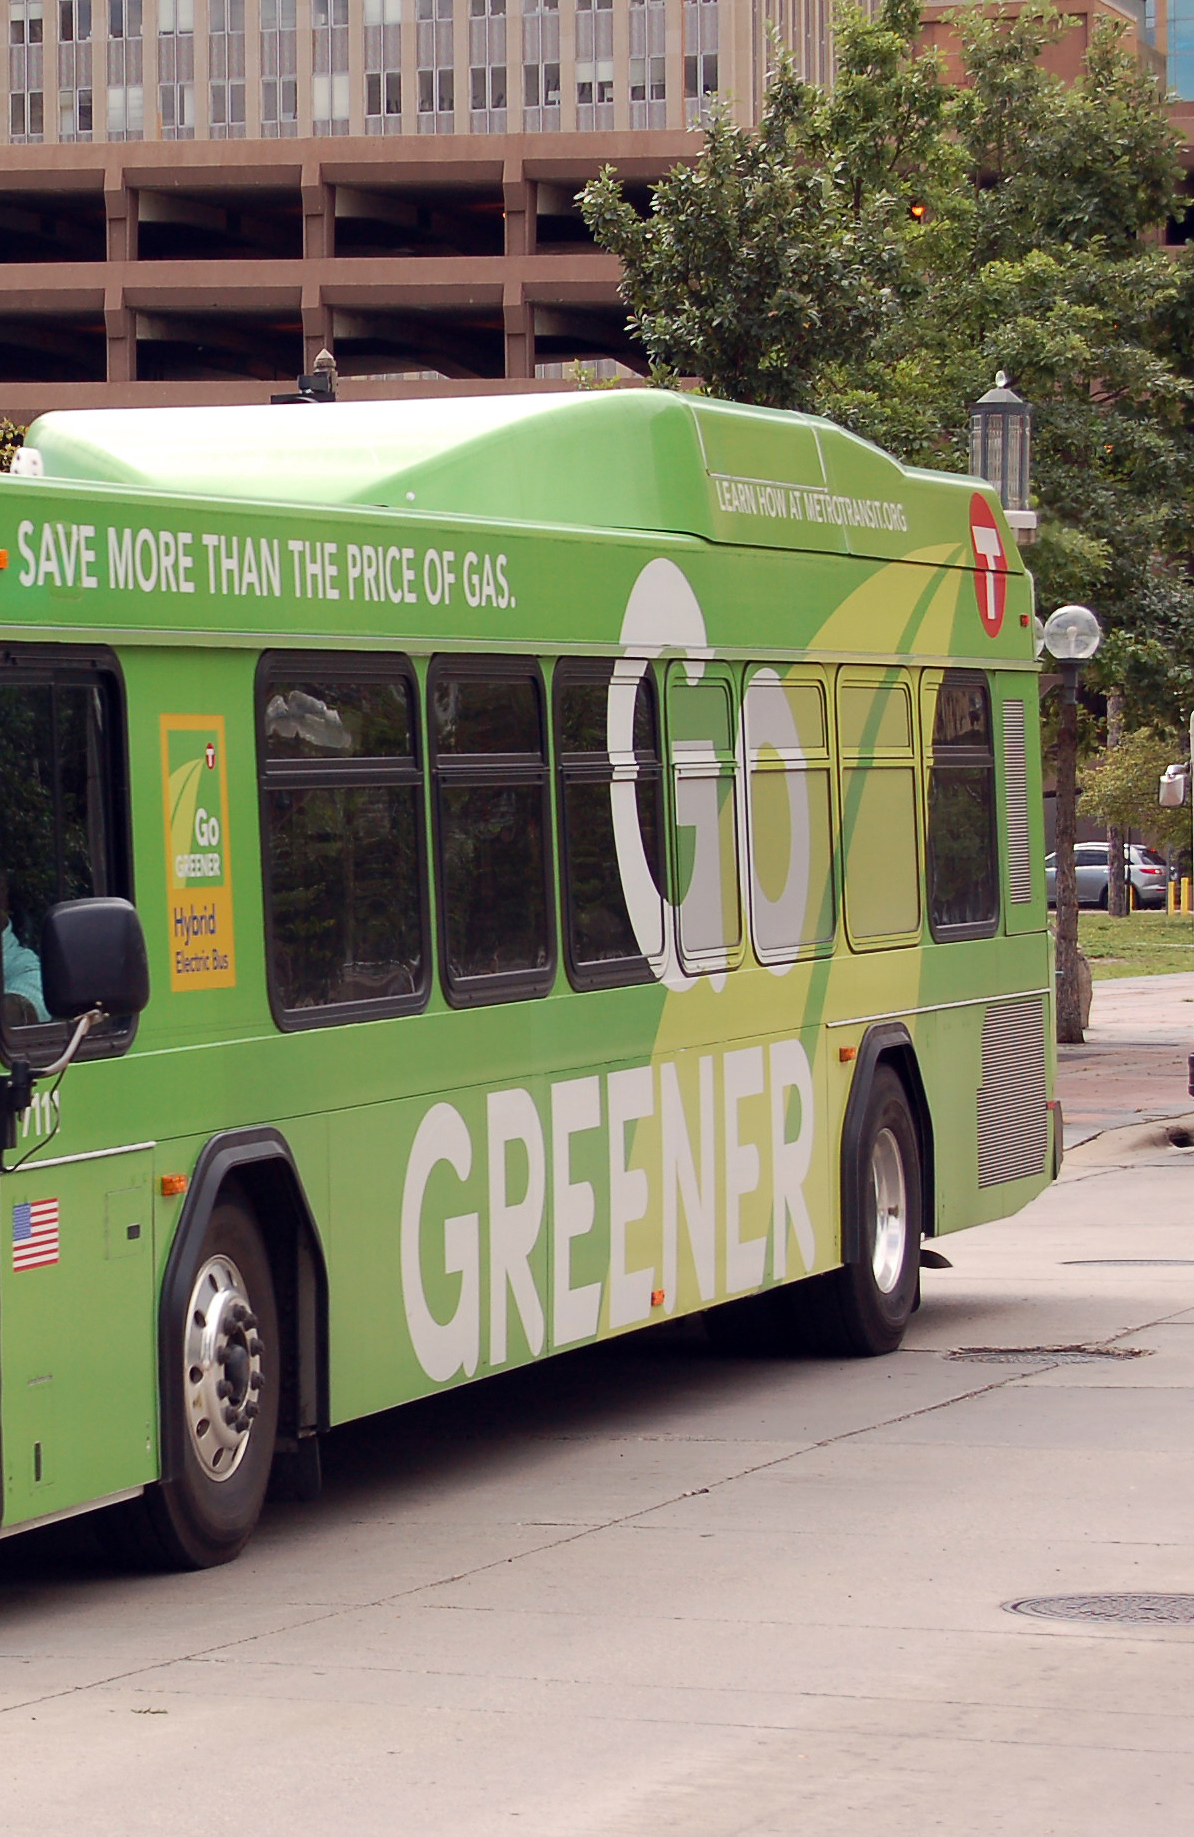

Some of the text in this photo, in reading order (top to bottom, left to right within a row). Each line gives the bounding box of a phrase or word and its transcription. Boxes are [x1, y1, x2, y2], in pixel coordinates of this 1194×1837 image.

[715, 480, 908, 532] LEARN HOW AT METROTRANSIT.ORG
[17, 520, 516, 609] SAVE MORE THAN THE PRICE OF GAS.
[195, 808, 220, 847] Go
[175, 853, 221, 878] GREENER
[173, 903, 217, 946] Hybrid
[176, 948, 229, 975] Electric Bus
[401, 1038, 815, 1382] GREENER
